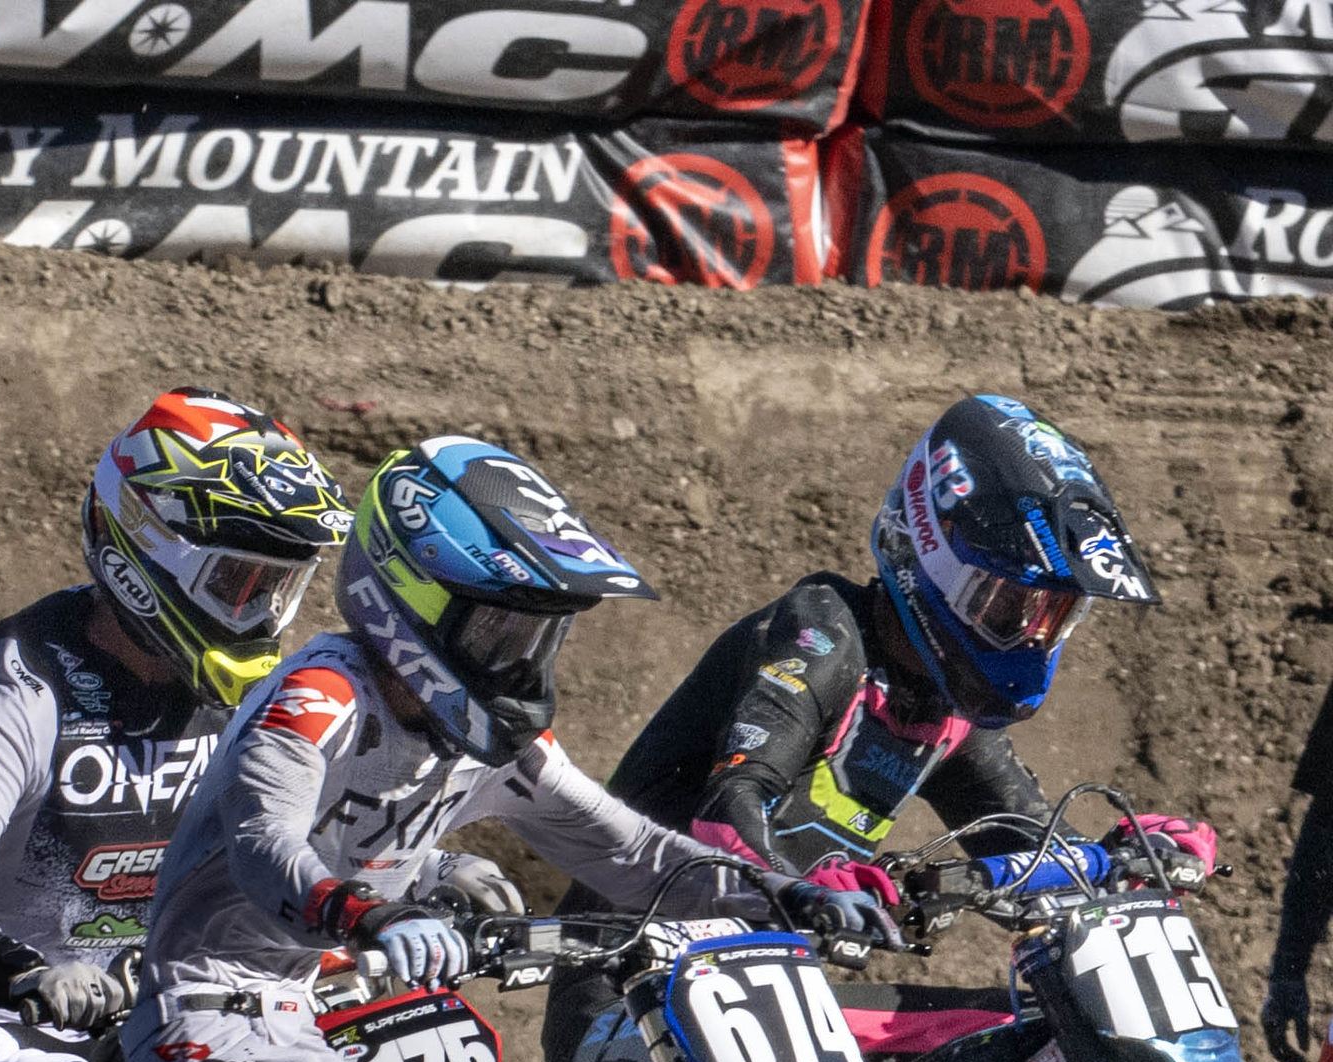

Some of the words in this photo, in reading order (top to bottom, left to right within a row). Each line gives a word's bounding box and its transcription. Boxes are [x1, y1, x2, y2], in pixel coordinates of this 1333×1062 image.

[71, 113, 583, 203] MOUNTAIN
[103, 555, 152, 610] Arai
[347, 576, 463, 702] FXR
[505, 965, 554, 987] ASV
[833, 940, 871, 959] ASV
[1073, 916, 1238, 1040] 113
